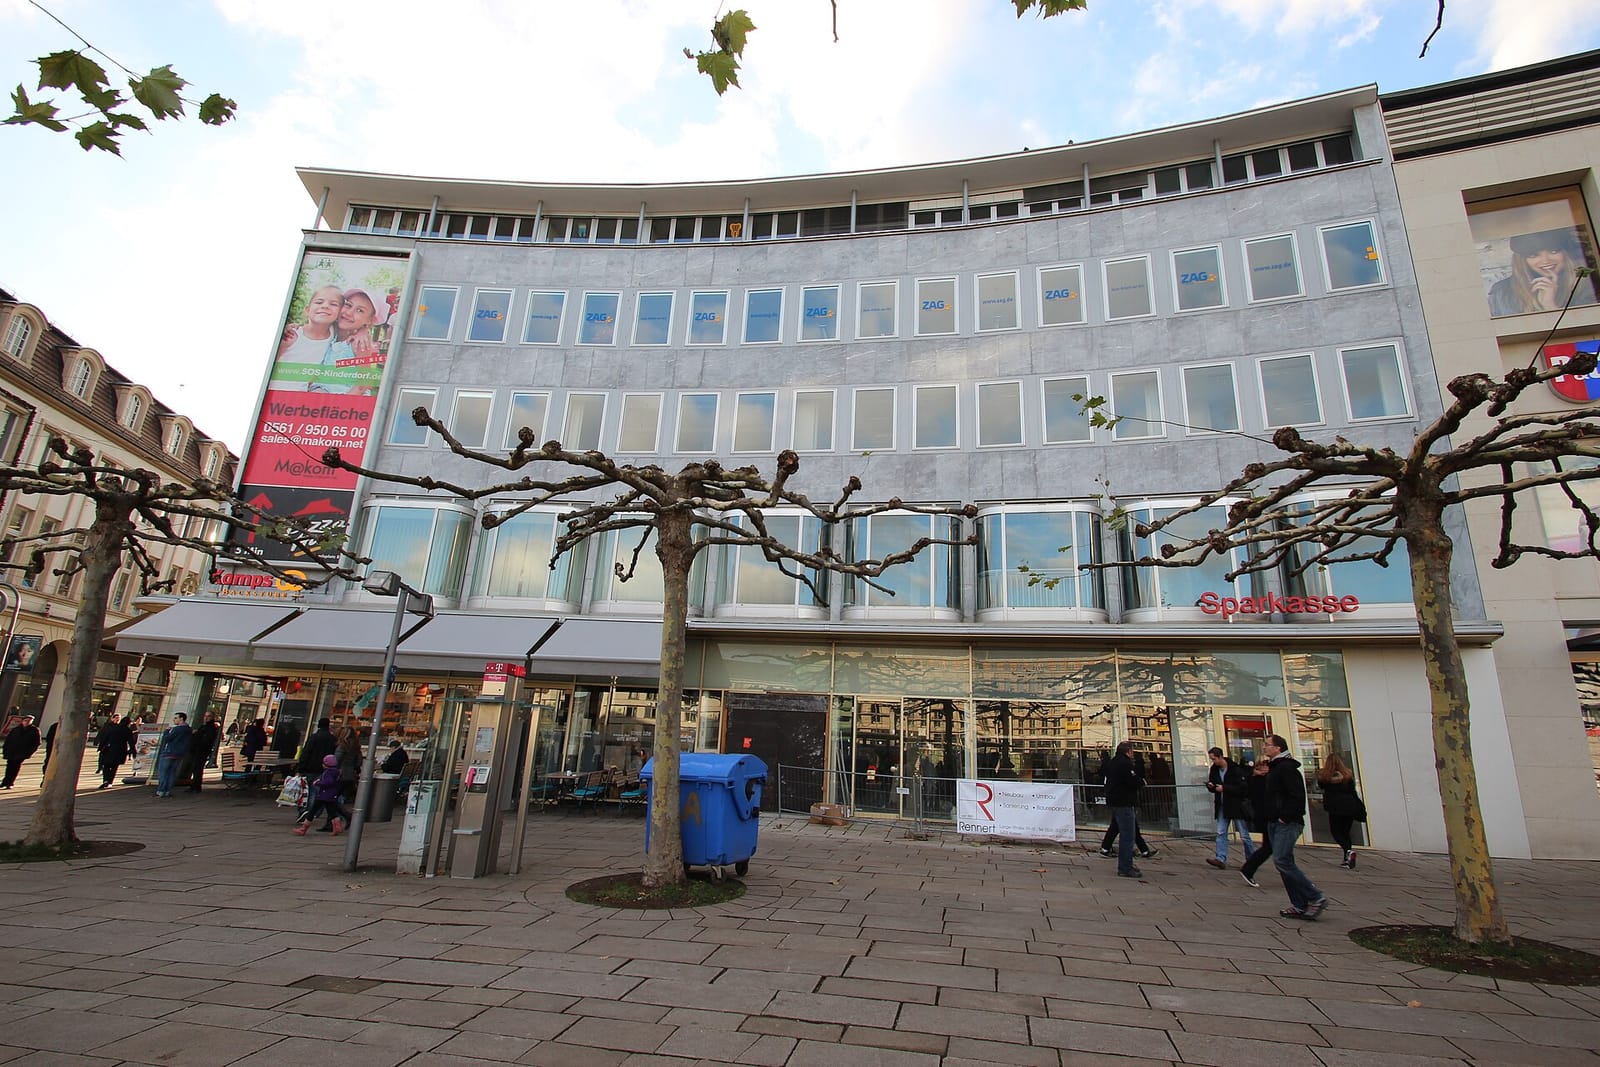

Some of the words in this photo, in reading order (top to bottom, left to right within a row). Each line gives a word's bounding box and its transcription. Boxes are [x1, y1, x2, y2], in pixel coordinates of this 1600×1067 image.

[1180, 271, 1208, 284] ZAG
[1045, 288, 1070, 300] ZAG
[922, 300, 944, 310] ZAG
[476, 309, 498, 319] ZAG
[586, 313, 607, 322] ZAG
[694, 312, 716, 321] ZAG
[806, 307, 828, 317] ZAG
[336, 358, 365, 367] HELFEN
[269, 402, 369, 420] Werbefläche
[264, 422, 293, 433] 0561
[296, 423, 304, 434] /
[305, 424, 328, 436] 950
[331, 426, 347, 438] 65
[351, 427, 366, 439] 00
[260, 434, 364, 449] sales@makom.net
[1200, 591, 1360, 619] Sparkasse
[1001, 791, 1024, 799] Neubau
[976, 783, 995, 821] R
[1003, 803, 1029, 811] Sanierung
[959, 821, 996, 834] Rennert
